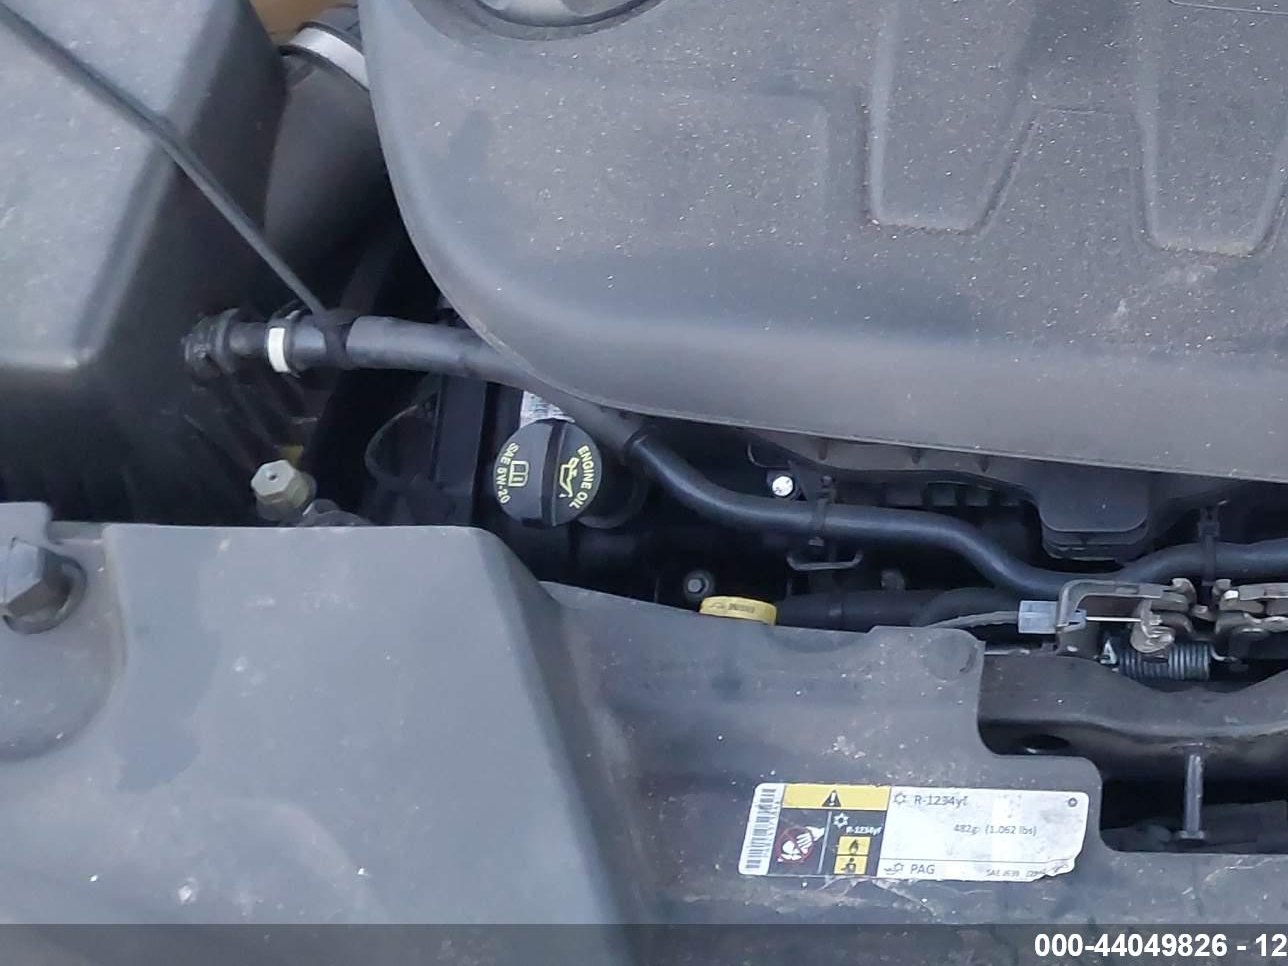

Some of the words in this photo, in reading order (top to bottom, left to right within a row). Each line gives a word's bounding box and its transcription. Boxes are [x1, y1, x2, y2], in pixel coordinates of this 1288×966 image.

[499, 442, 520, 465] SAE
[576, 444, 595, 491] ENGINE
[568, 490, 589, 510] OIL
[913, 793, 970, 810] R-1234yf
[910, 863, 936, 875] PAG
